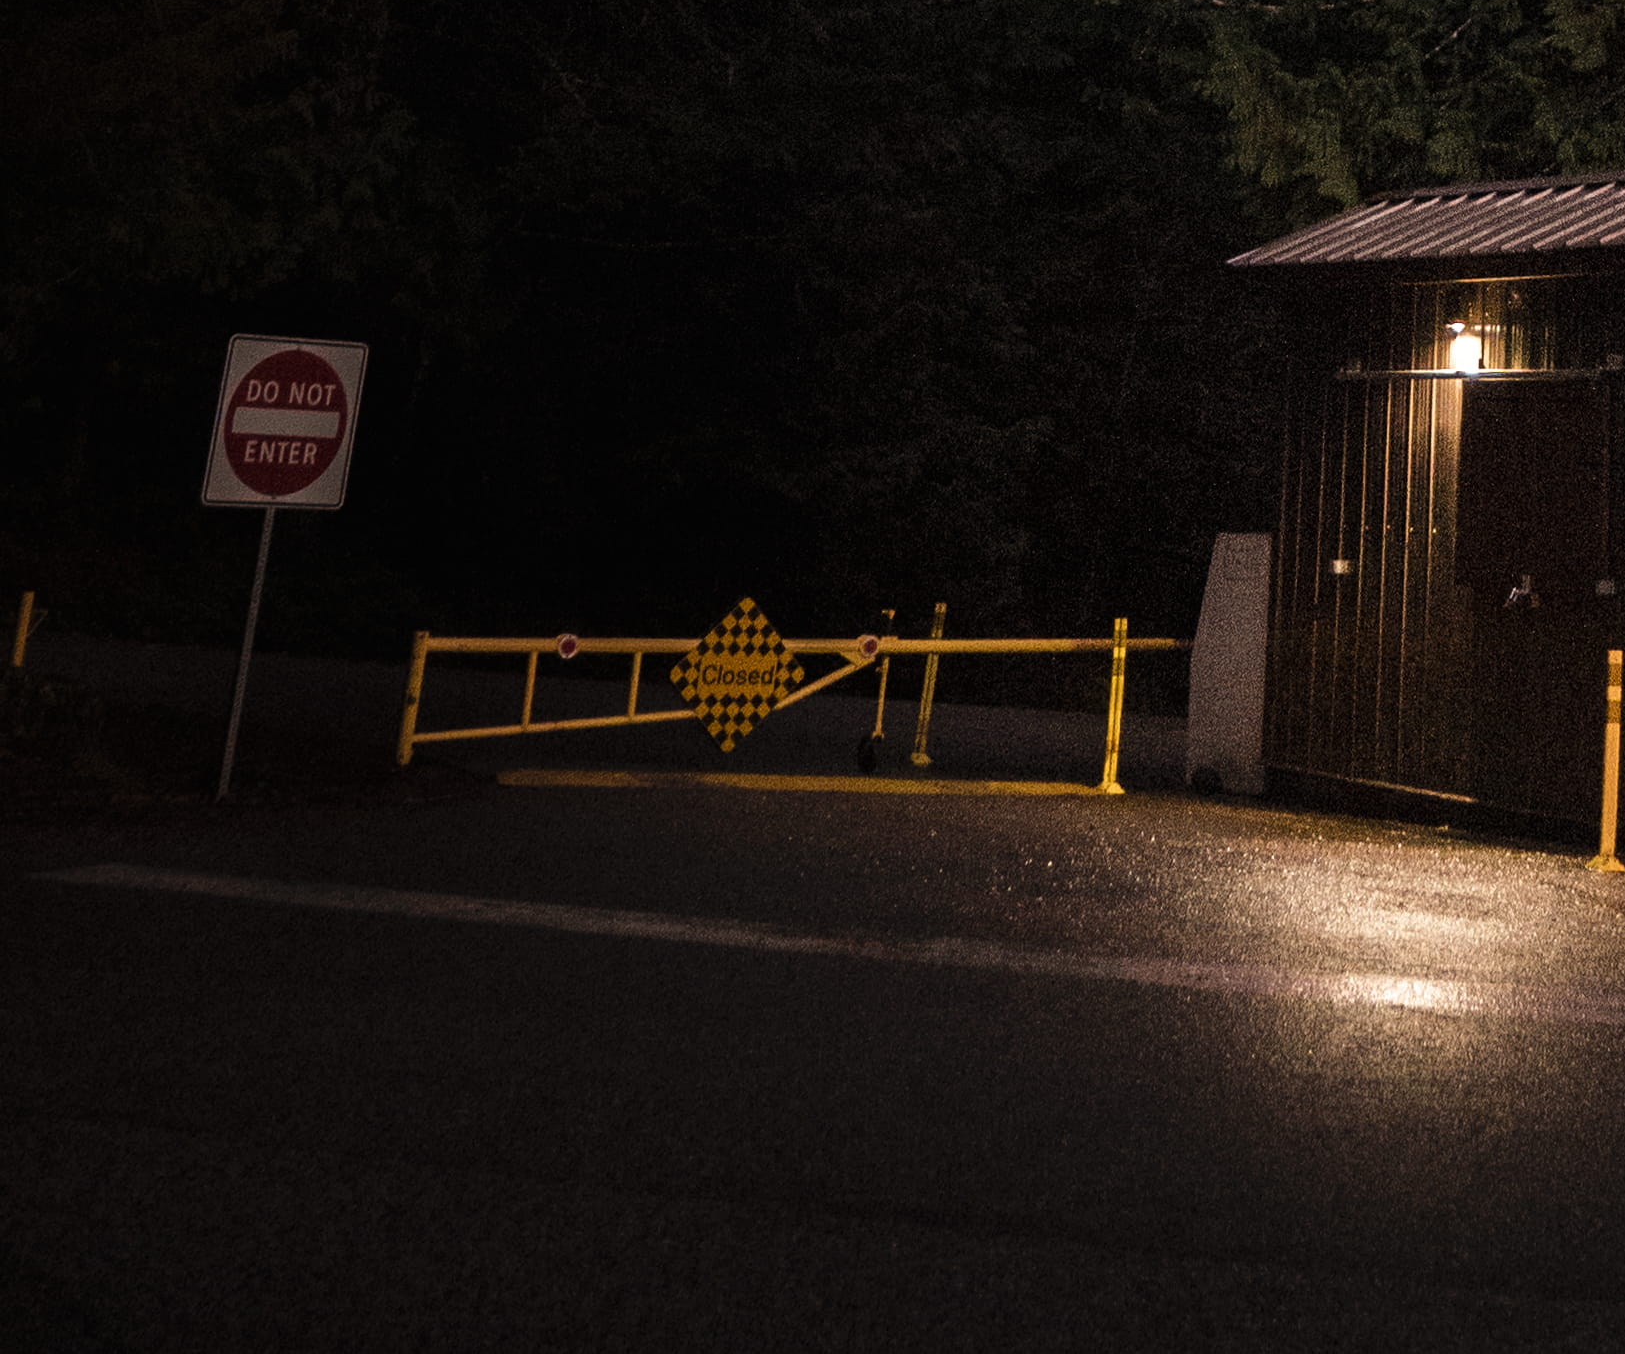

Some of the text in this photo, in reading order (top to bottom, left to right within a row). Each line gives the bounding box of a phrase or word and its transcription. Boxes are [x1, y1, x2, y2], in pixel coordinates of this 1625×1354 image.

[246, 379, 337, 407] DO NOT
[243, 440, 318, 465] ENTER
[701, 664, 776, 686] Closed
